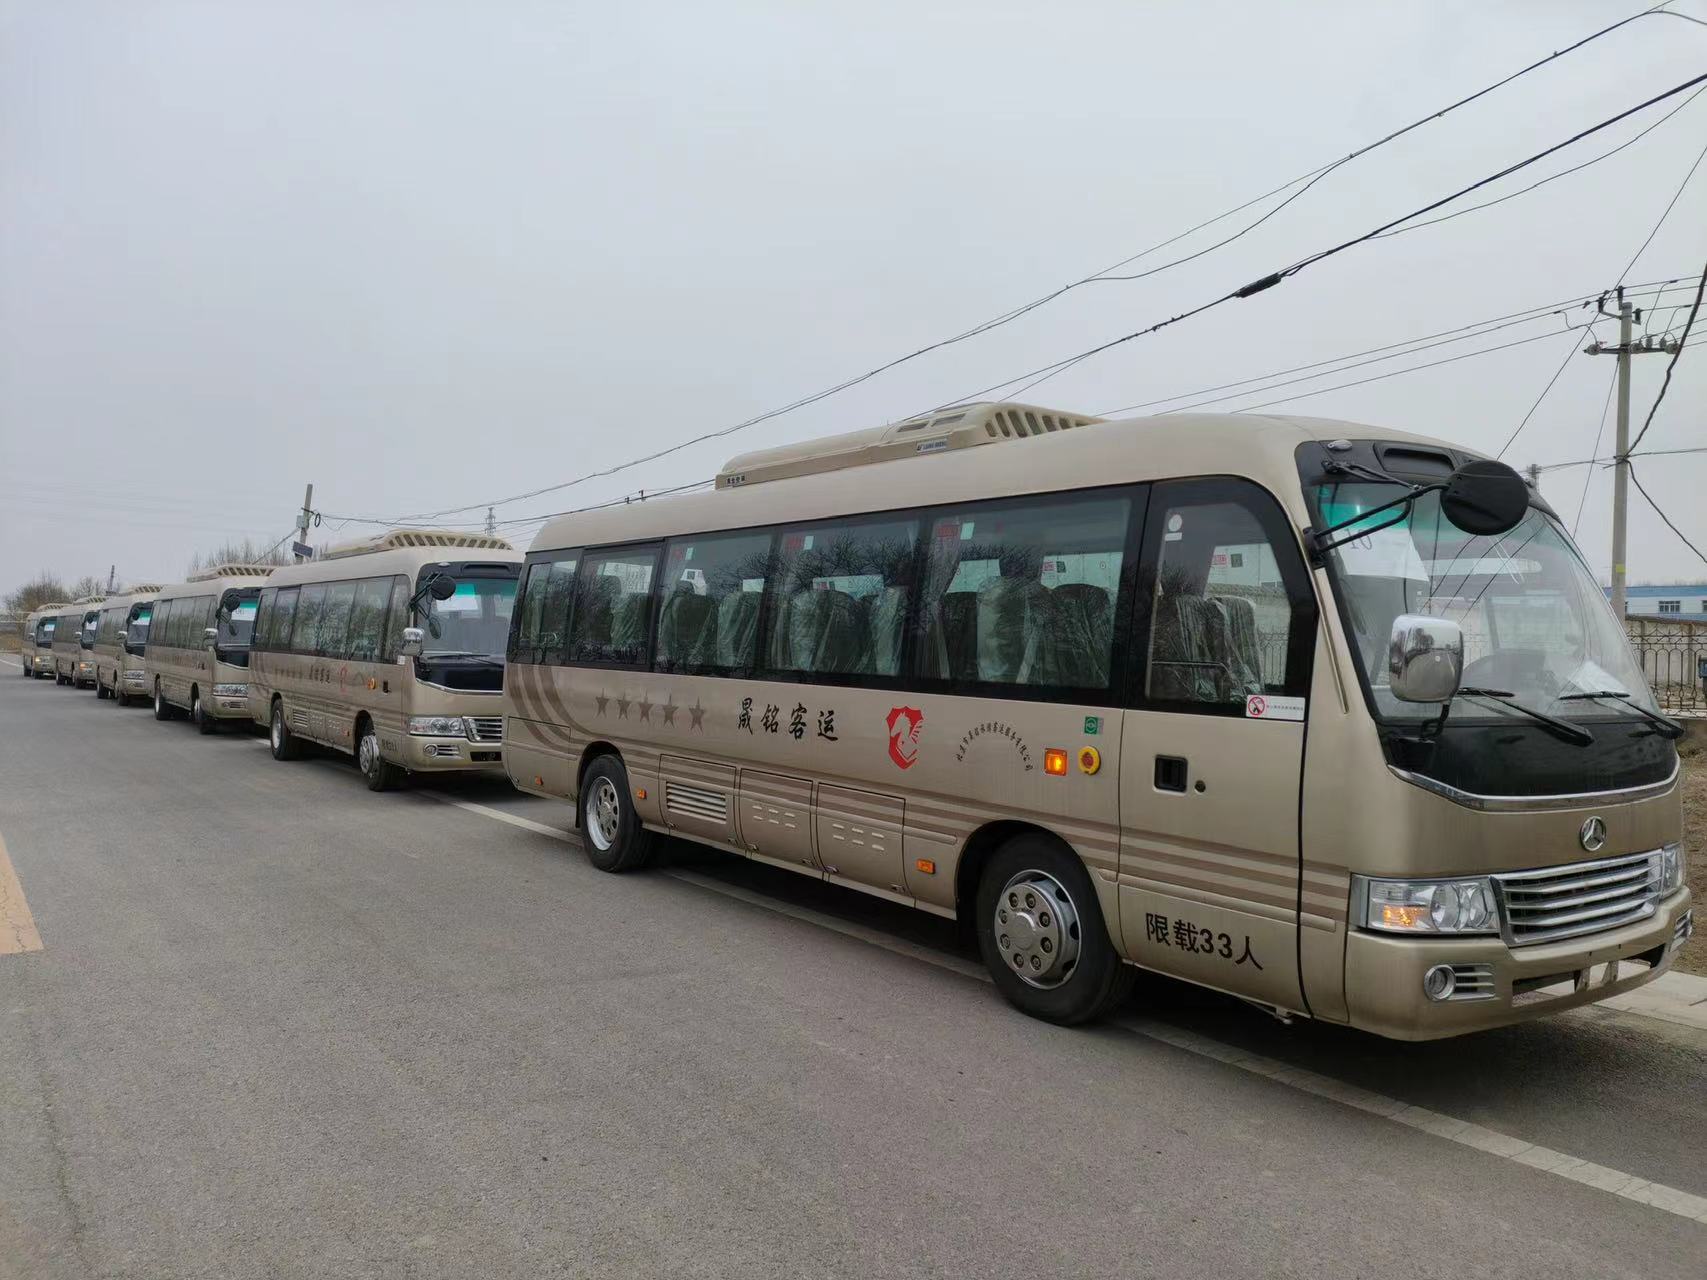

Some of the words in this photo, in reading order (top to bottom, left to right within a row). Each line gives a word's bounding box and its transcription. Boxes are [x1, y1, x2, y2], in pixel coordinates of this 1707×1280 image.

[738, 697, 838, 741] 晟铭客运
[1146, 912, 1264, 971] 限载33人
